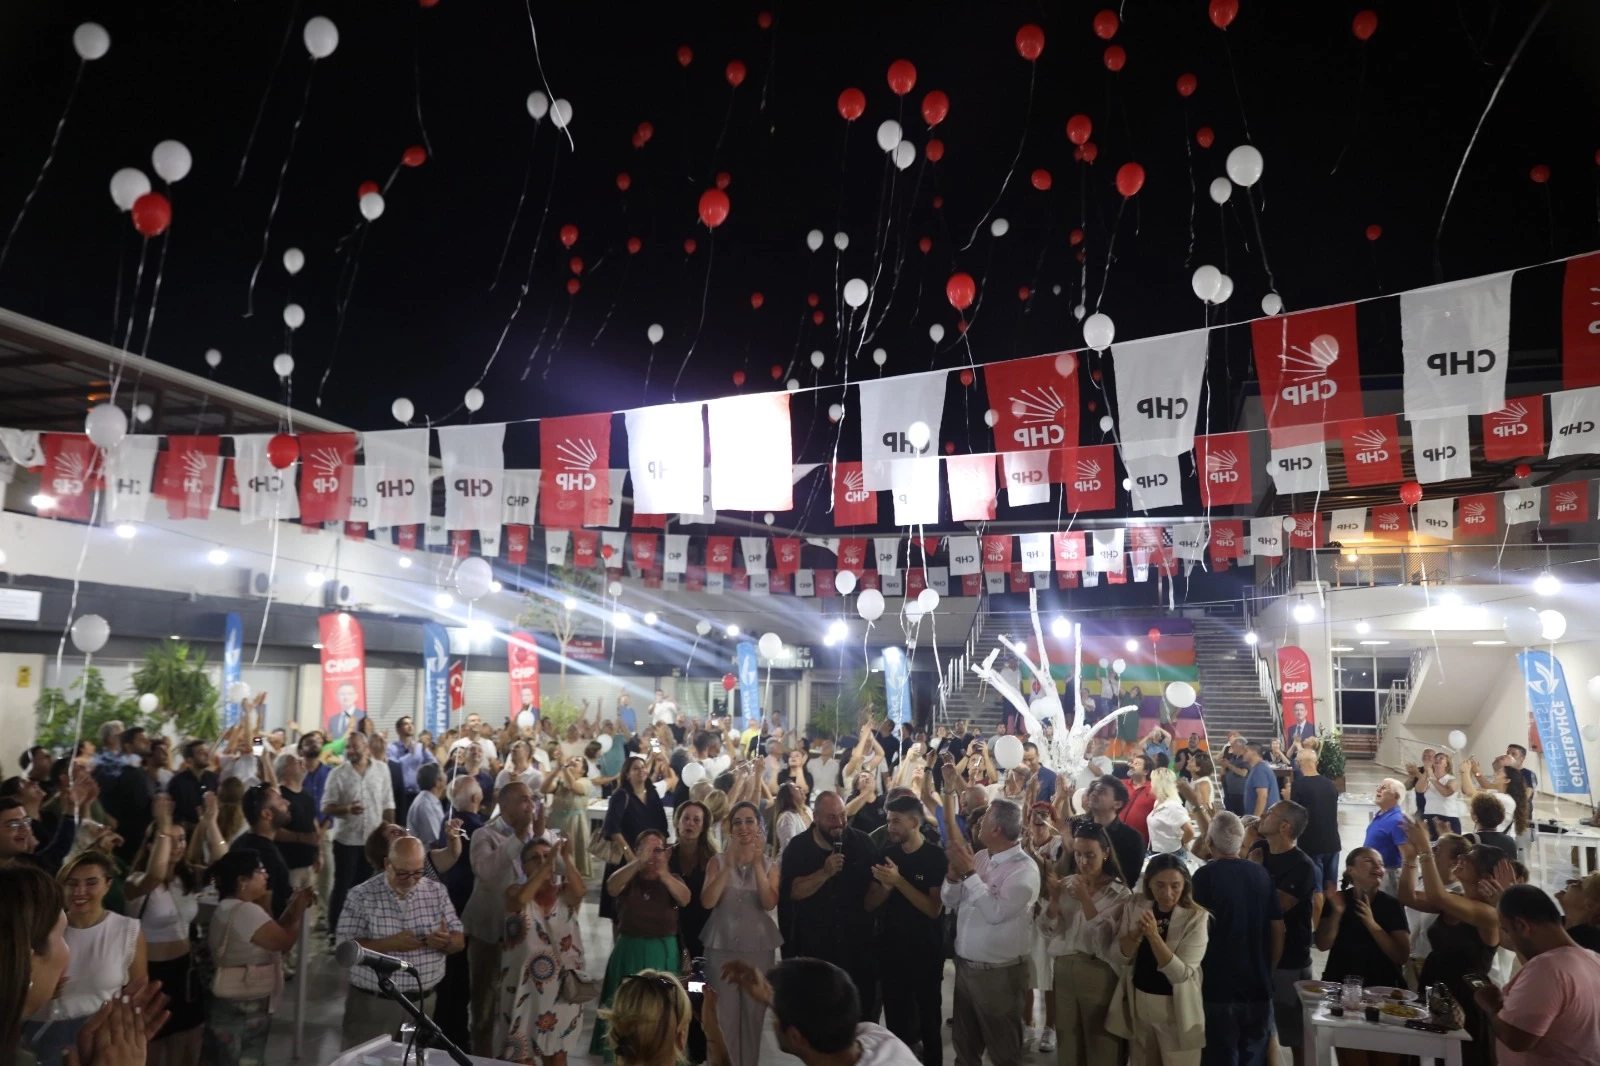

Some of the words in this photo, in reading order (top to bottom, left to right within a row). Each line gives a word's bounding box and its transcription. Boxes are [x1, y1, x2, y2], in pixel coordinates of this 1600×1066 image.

[507, 495, 529, 507] CHP
[845, 490, 869, 502] CHP
[324, 658, 361, 674] CHP
[511, 667, 536, 680] CHP
[1283, 682, 1308, 694] CHP
